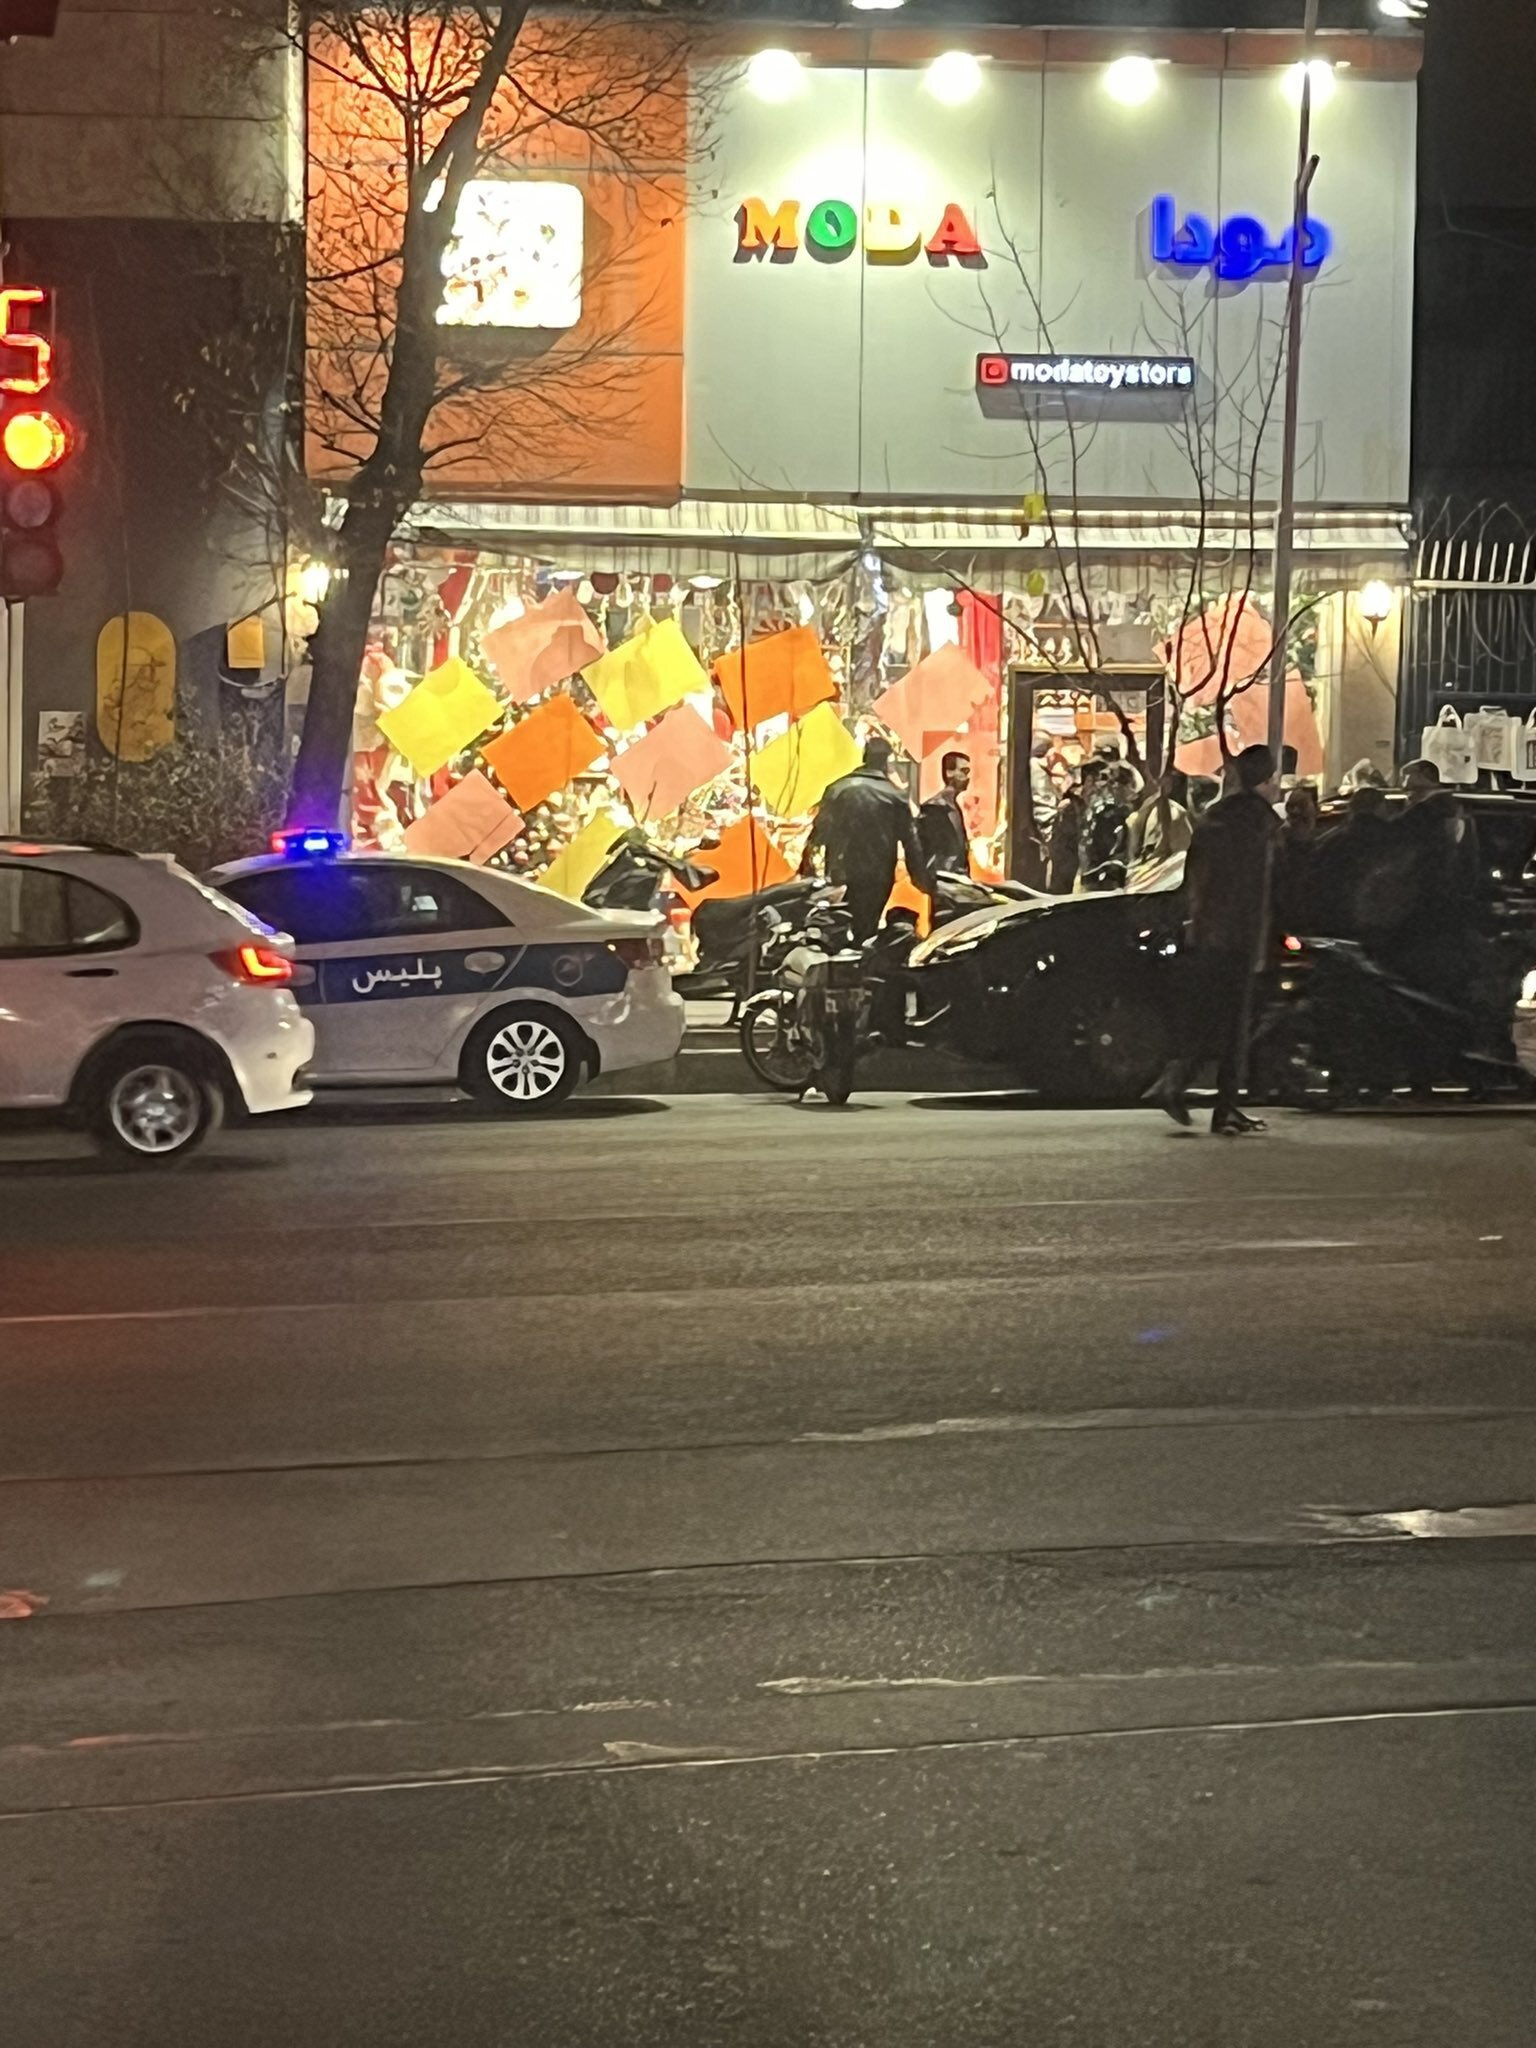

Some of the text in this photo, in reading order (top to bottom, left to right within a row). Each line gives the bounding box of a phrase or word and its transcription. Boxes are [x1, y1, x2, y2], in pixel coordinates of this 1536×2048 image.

[740, 196, 984, 259] MODA
[1152, 194, 1331, 280] مودا
[0, 289, 51, 394] 5
[352, 957, 442, 994] پلیس
